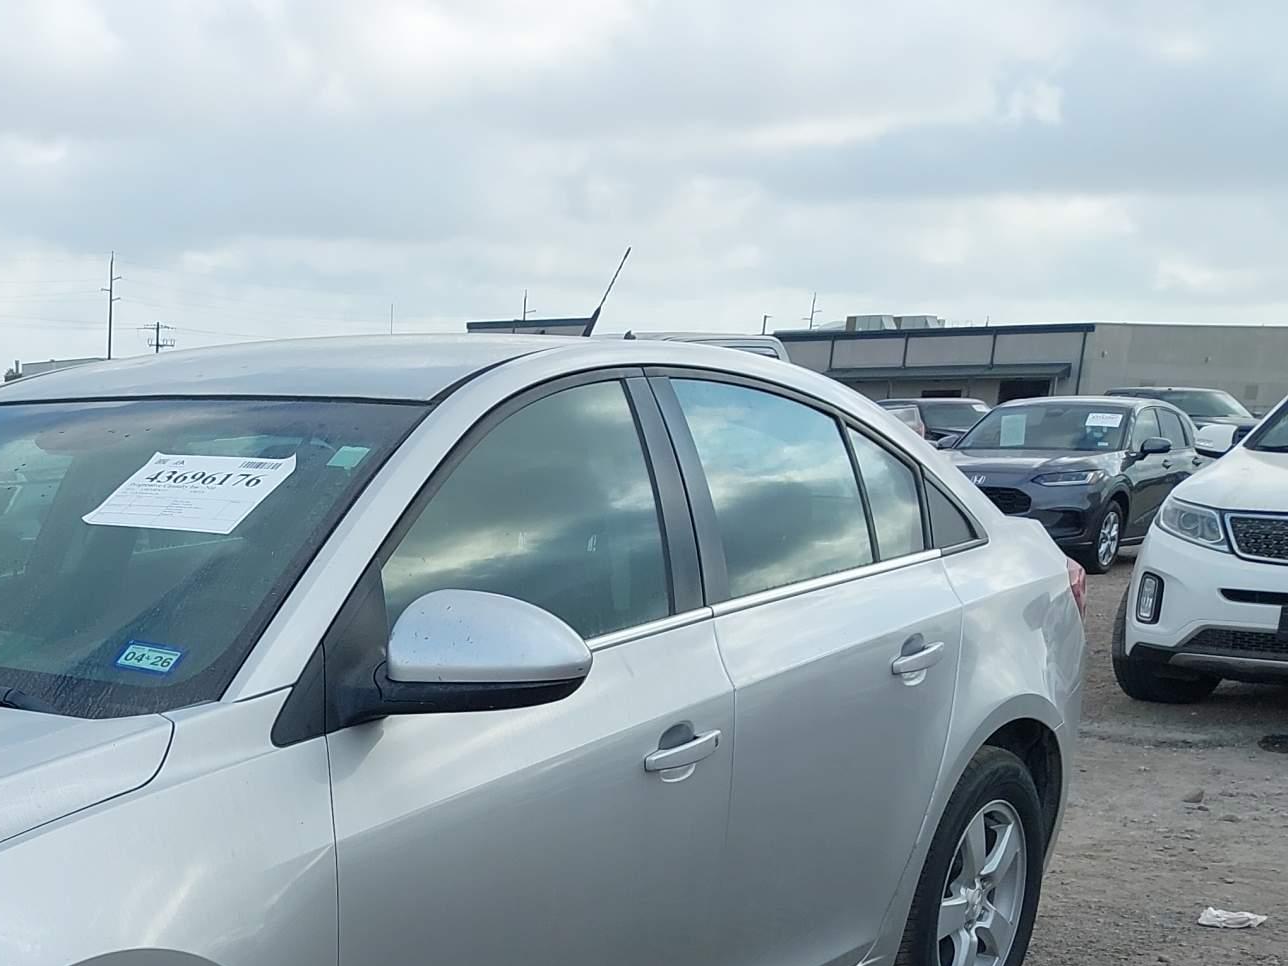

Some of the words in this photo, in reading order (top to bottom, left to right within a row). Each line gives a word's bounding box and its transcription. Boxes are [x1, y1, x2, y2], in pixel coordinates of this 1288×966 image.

[145, 470, 268, 488] 43696176
[124, 651, 146, 663] 04
[150, 655, 174, 668] 26
